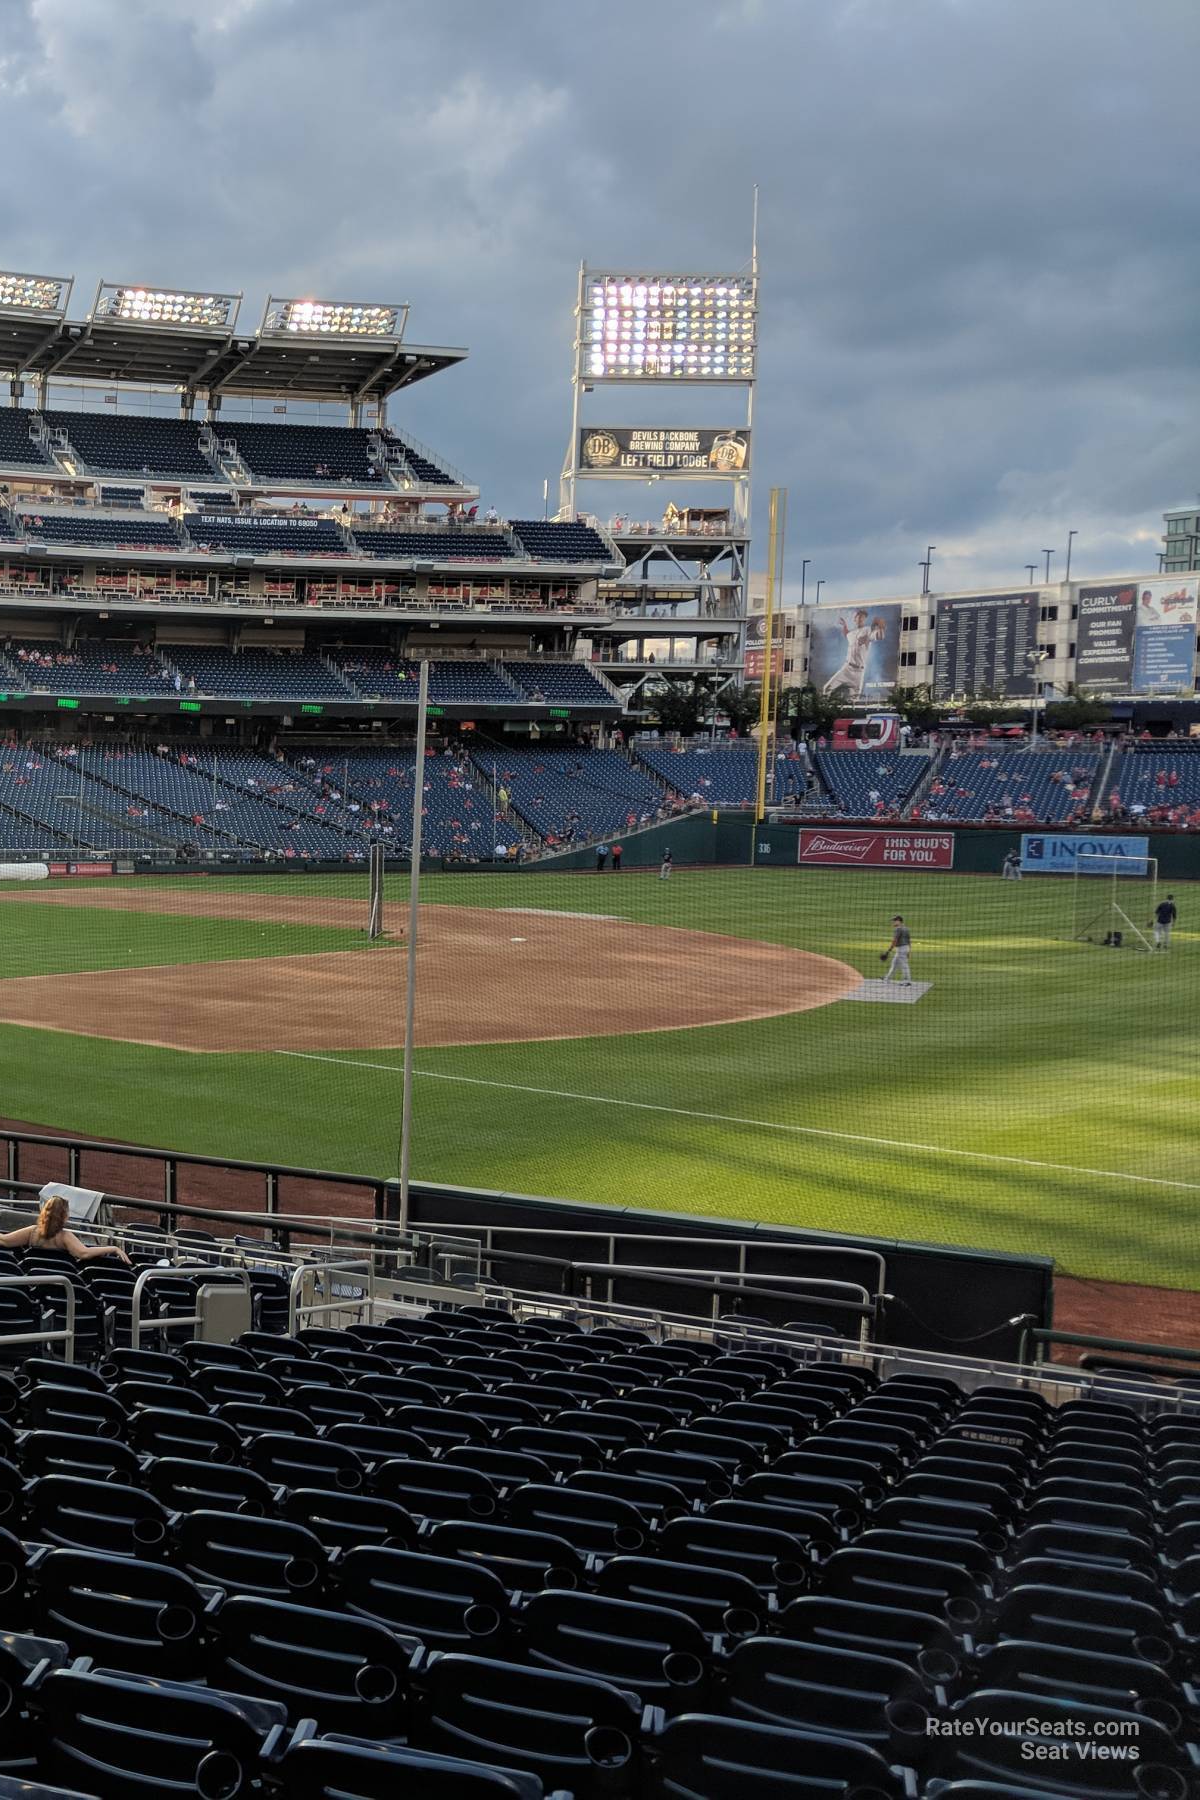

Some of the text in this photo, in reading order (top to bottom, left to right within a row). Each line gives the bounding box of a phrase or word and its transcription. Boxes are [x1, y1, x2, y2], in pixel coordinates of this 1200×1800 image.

[632, 431, 699, 442] DEVILS BACKBONE
[592, 439, 610, 454] DB
[630, 441, 700, 451] BREWING COMPANY
[621, 454, 708, 468] LEFT FIELD LODGE
[201, 515, 215, 523] TEXT
[216, 516, 234, 525] NATS,
[234, 517, 252, 525] ISSUE
[259, 518, 288, 526] LOCATION
[289, 519, 297, 527] TO
[1082, 596, 1117, 607] CURLY
[1081, 605, 1132, 614] COMMITMENT
[758, 844, 771, 854] 336
[810, 840, 869, 853] Budweiser
[884, 837, 950, 849] THIS BUD'S
[1051, 841, 1126, 857] INOVA
[883, 850, 936, 862] FOR YOU.
